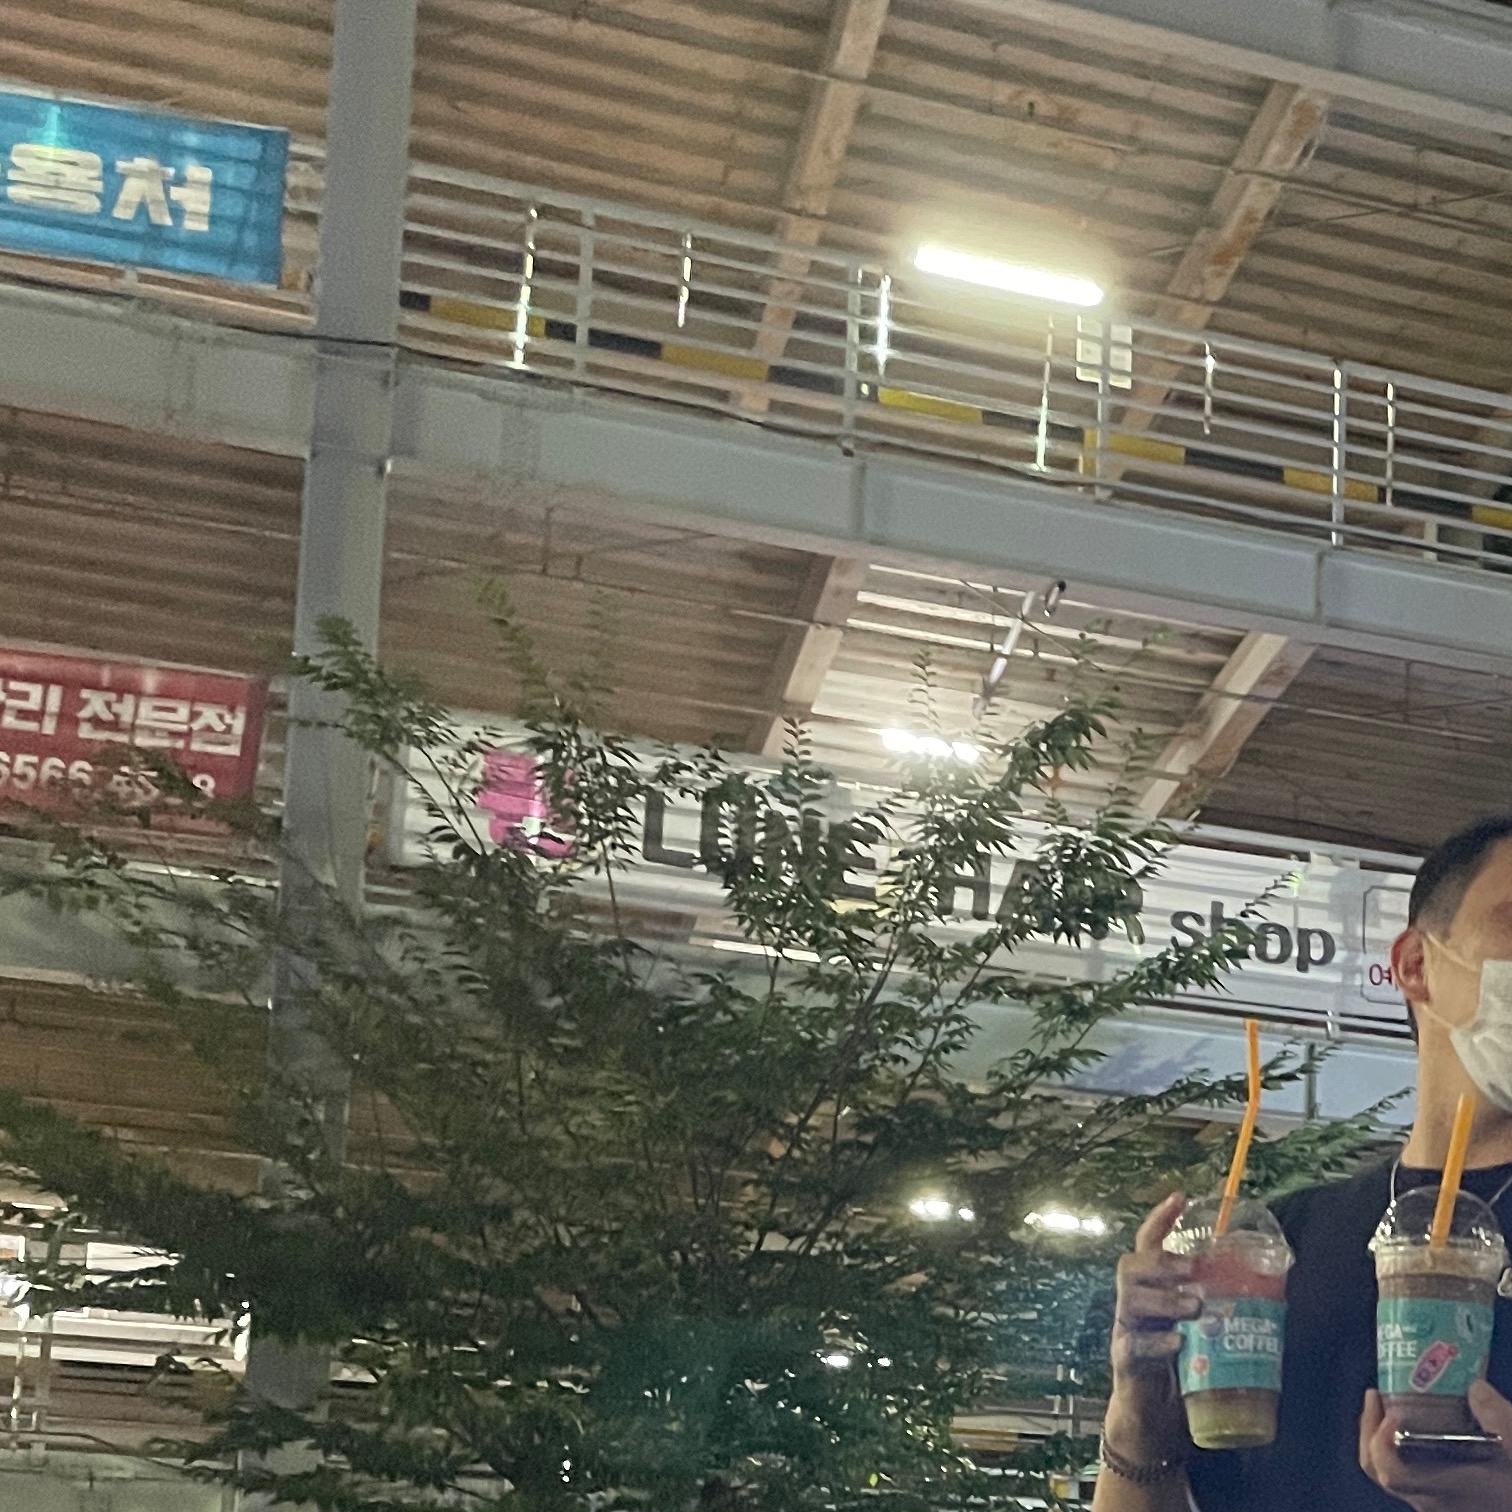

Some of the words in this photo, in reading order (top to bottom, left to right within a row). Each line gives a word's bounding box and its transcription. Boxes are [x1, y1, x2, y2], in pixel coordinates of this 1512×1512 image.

[0, 678, 62, 735] 리
[77, 688, 247, 756] 전문점
[934, 845, 1146, 945] HAR
[1170, 900, 1336, 973] shop
